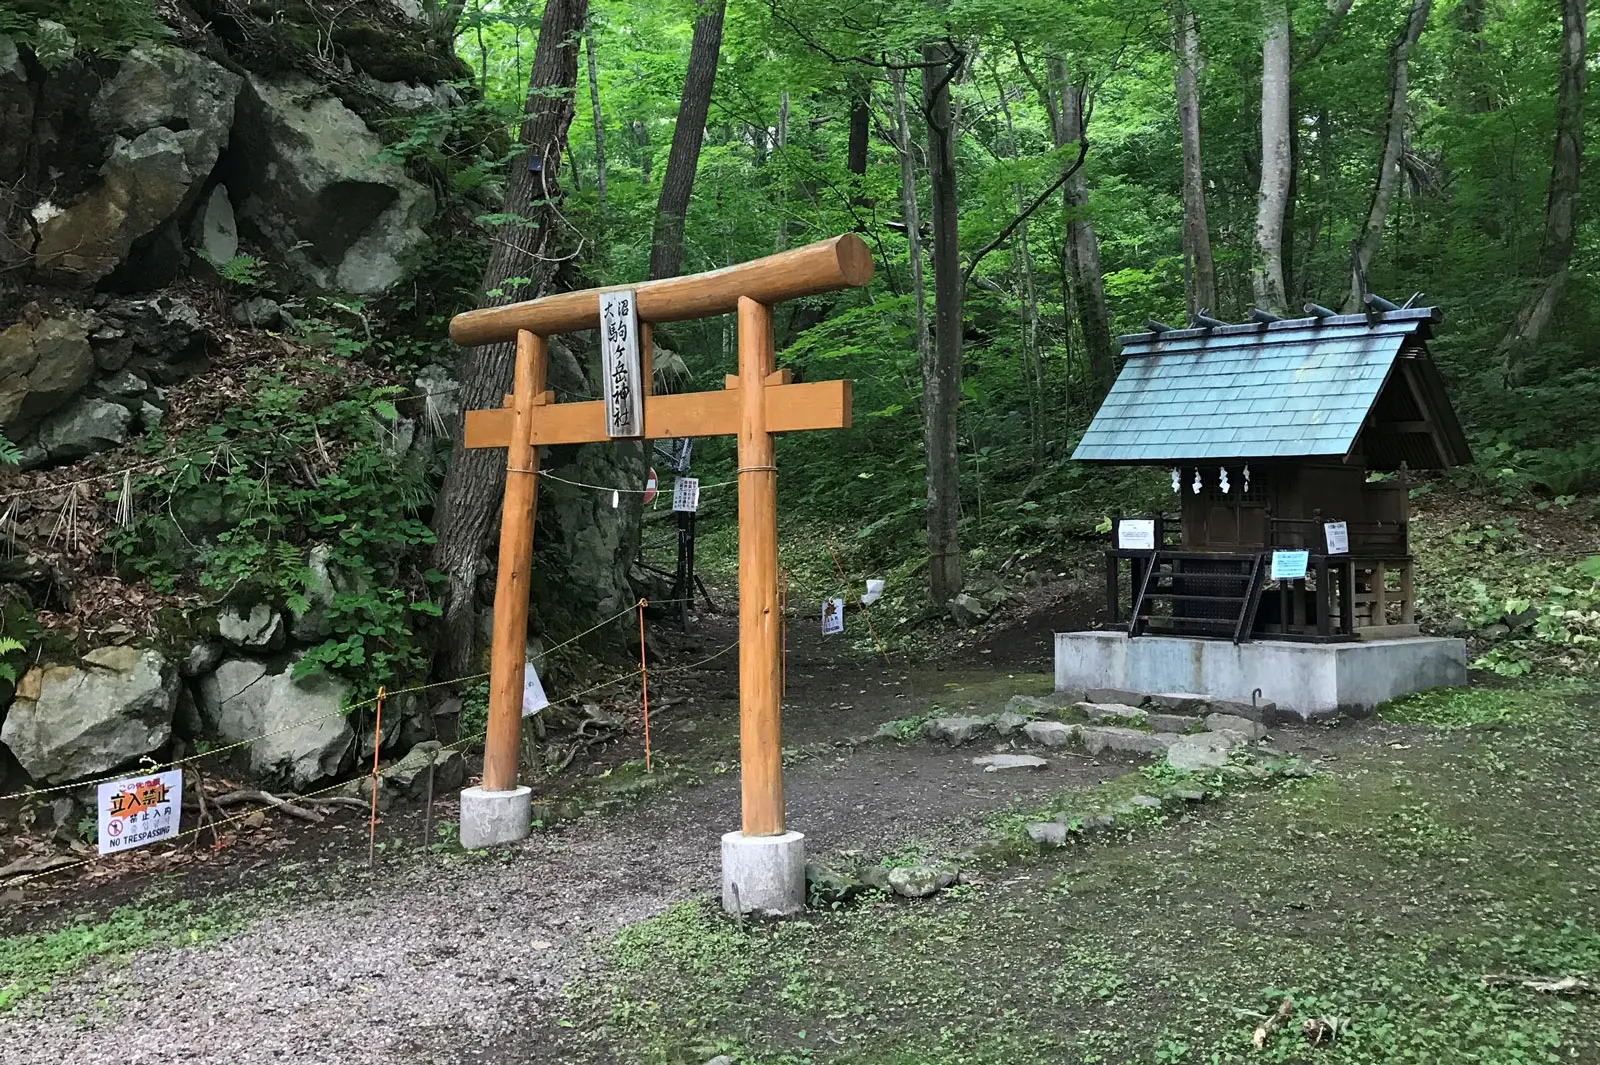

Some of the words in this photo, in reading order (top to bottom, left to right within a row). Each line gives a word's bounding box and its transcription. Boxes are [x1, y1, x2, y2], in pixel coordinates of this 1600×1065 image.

[604, 299, 629, 319] 大沼
[110, 782, 171, 816] 立入禁止
[109, 838, 121, 848] NO
[123, 825, 171, 845] TRESPASSING
